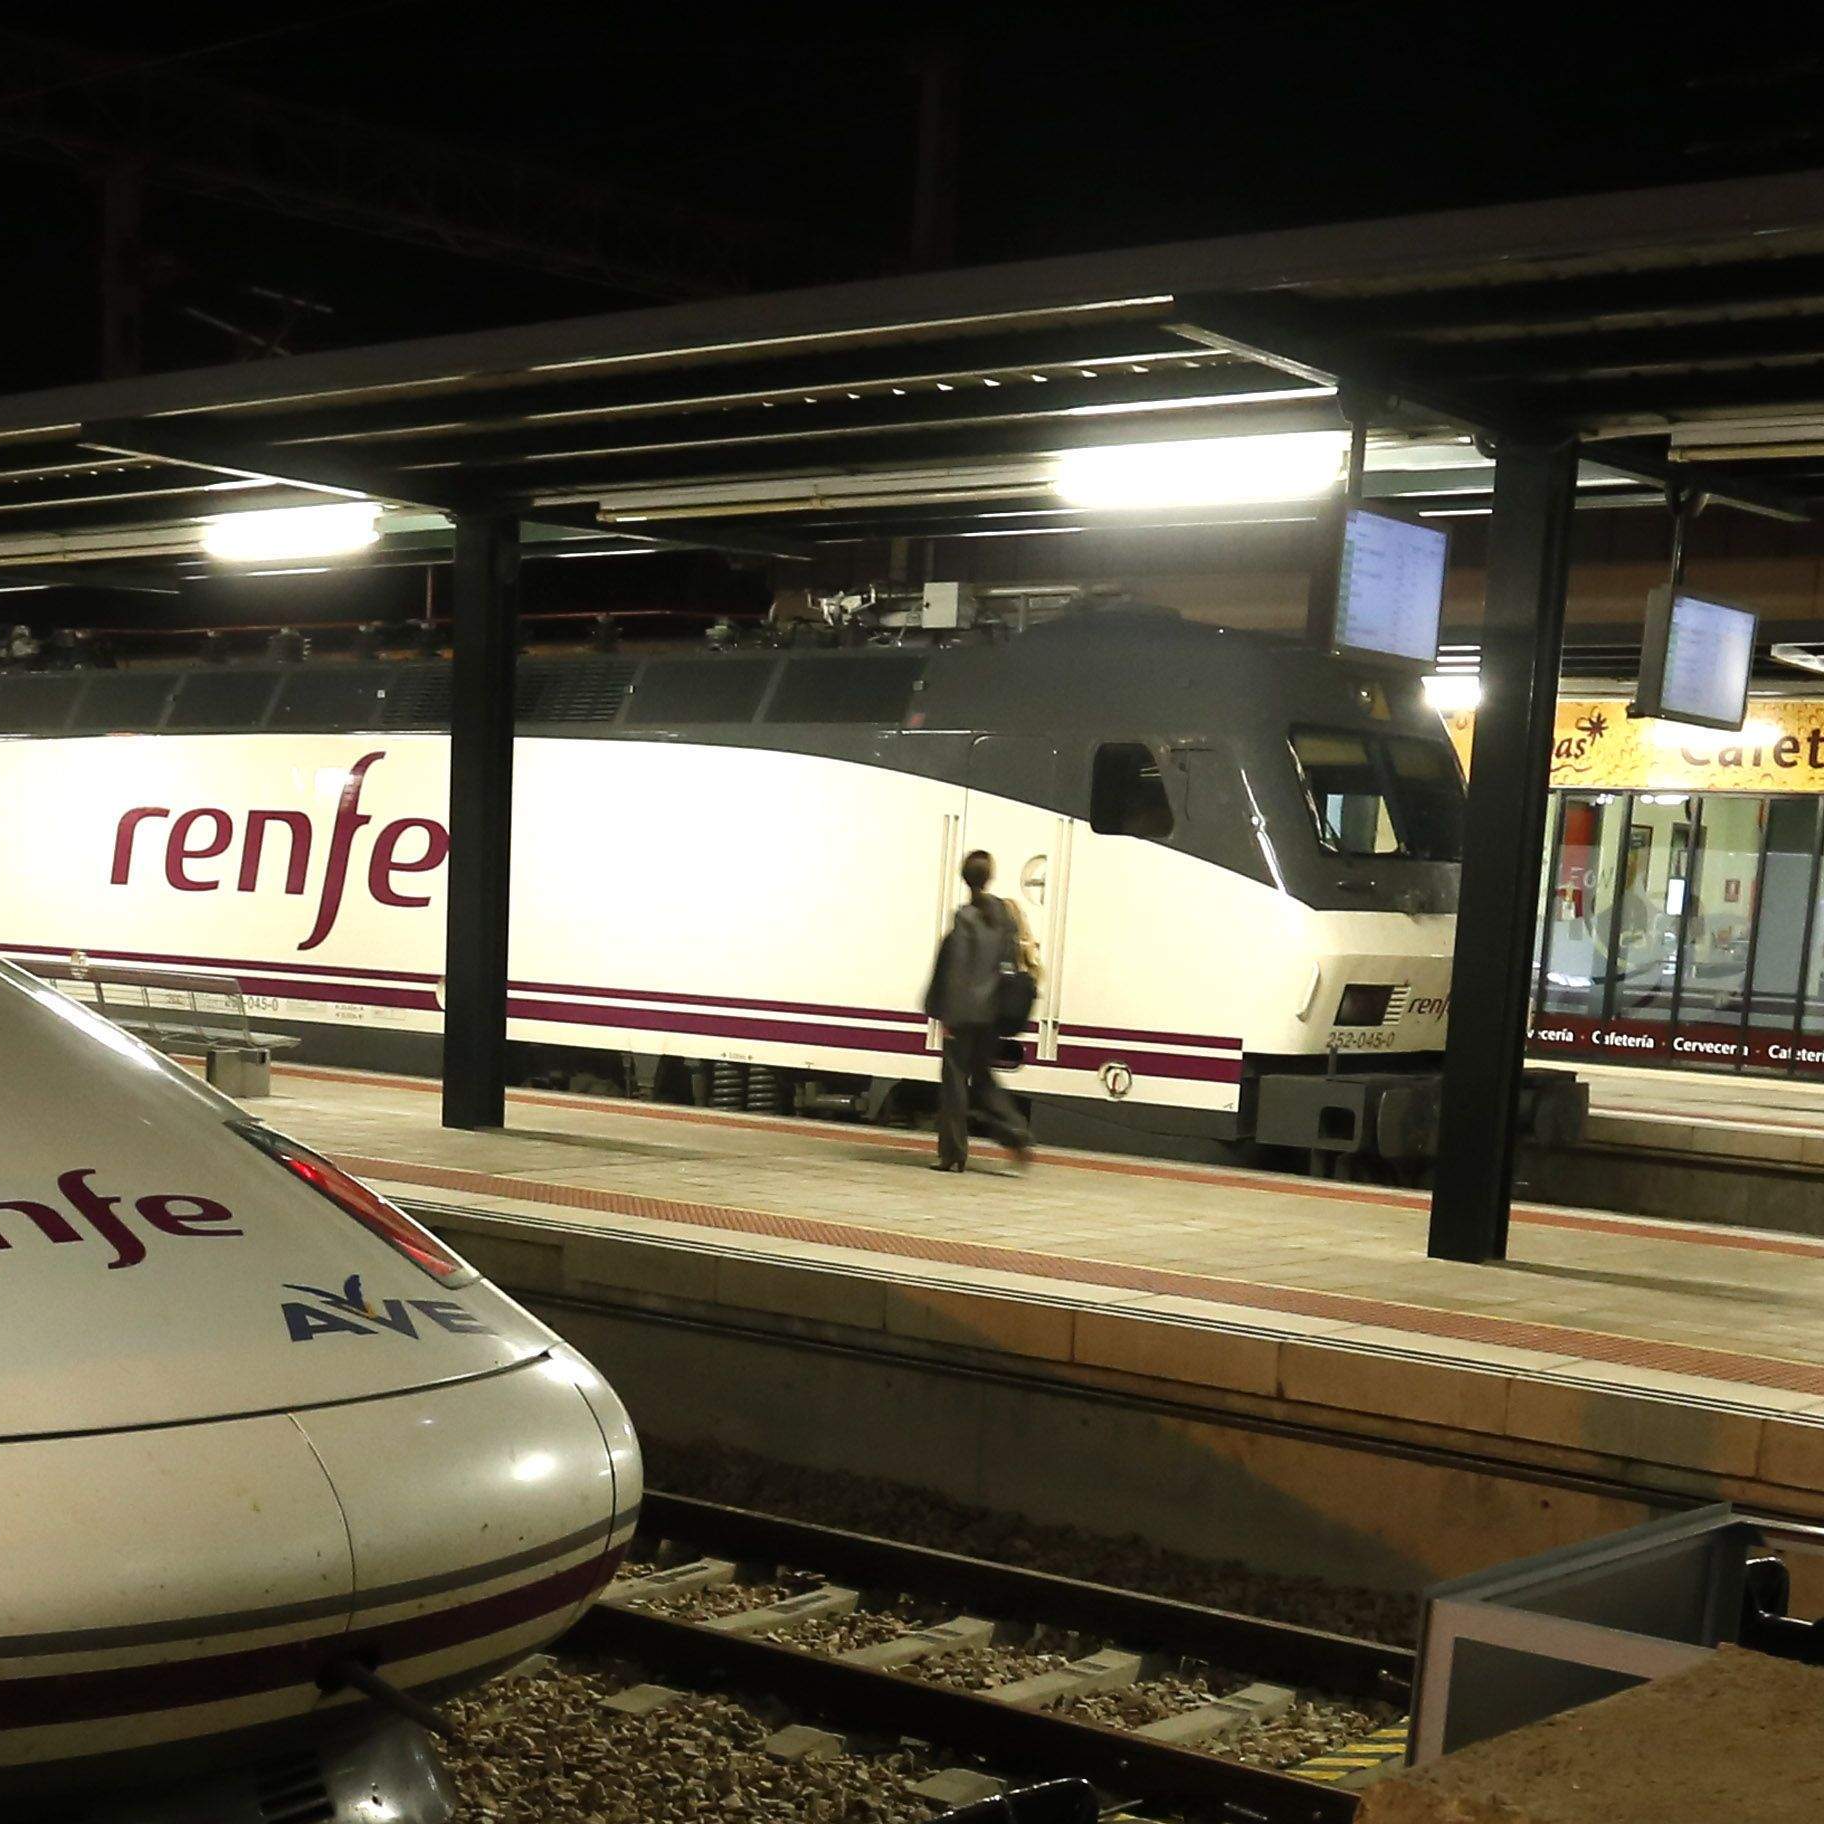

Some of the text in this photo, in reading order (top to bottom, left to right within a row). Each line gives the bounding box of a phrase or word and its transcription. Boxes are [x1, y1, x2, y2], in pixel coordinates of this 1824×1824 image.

[110, 751, 449, 951] renfe
[1673, 1037, 1749, 1056] Cervecer
[282, 1282, 497, 1343] AVE
